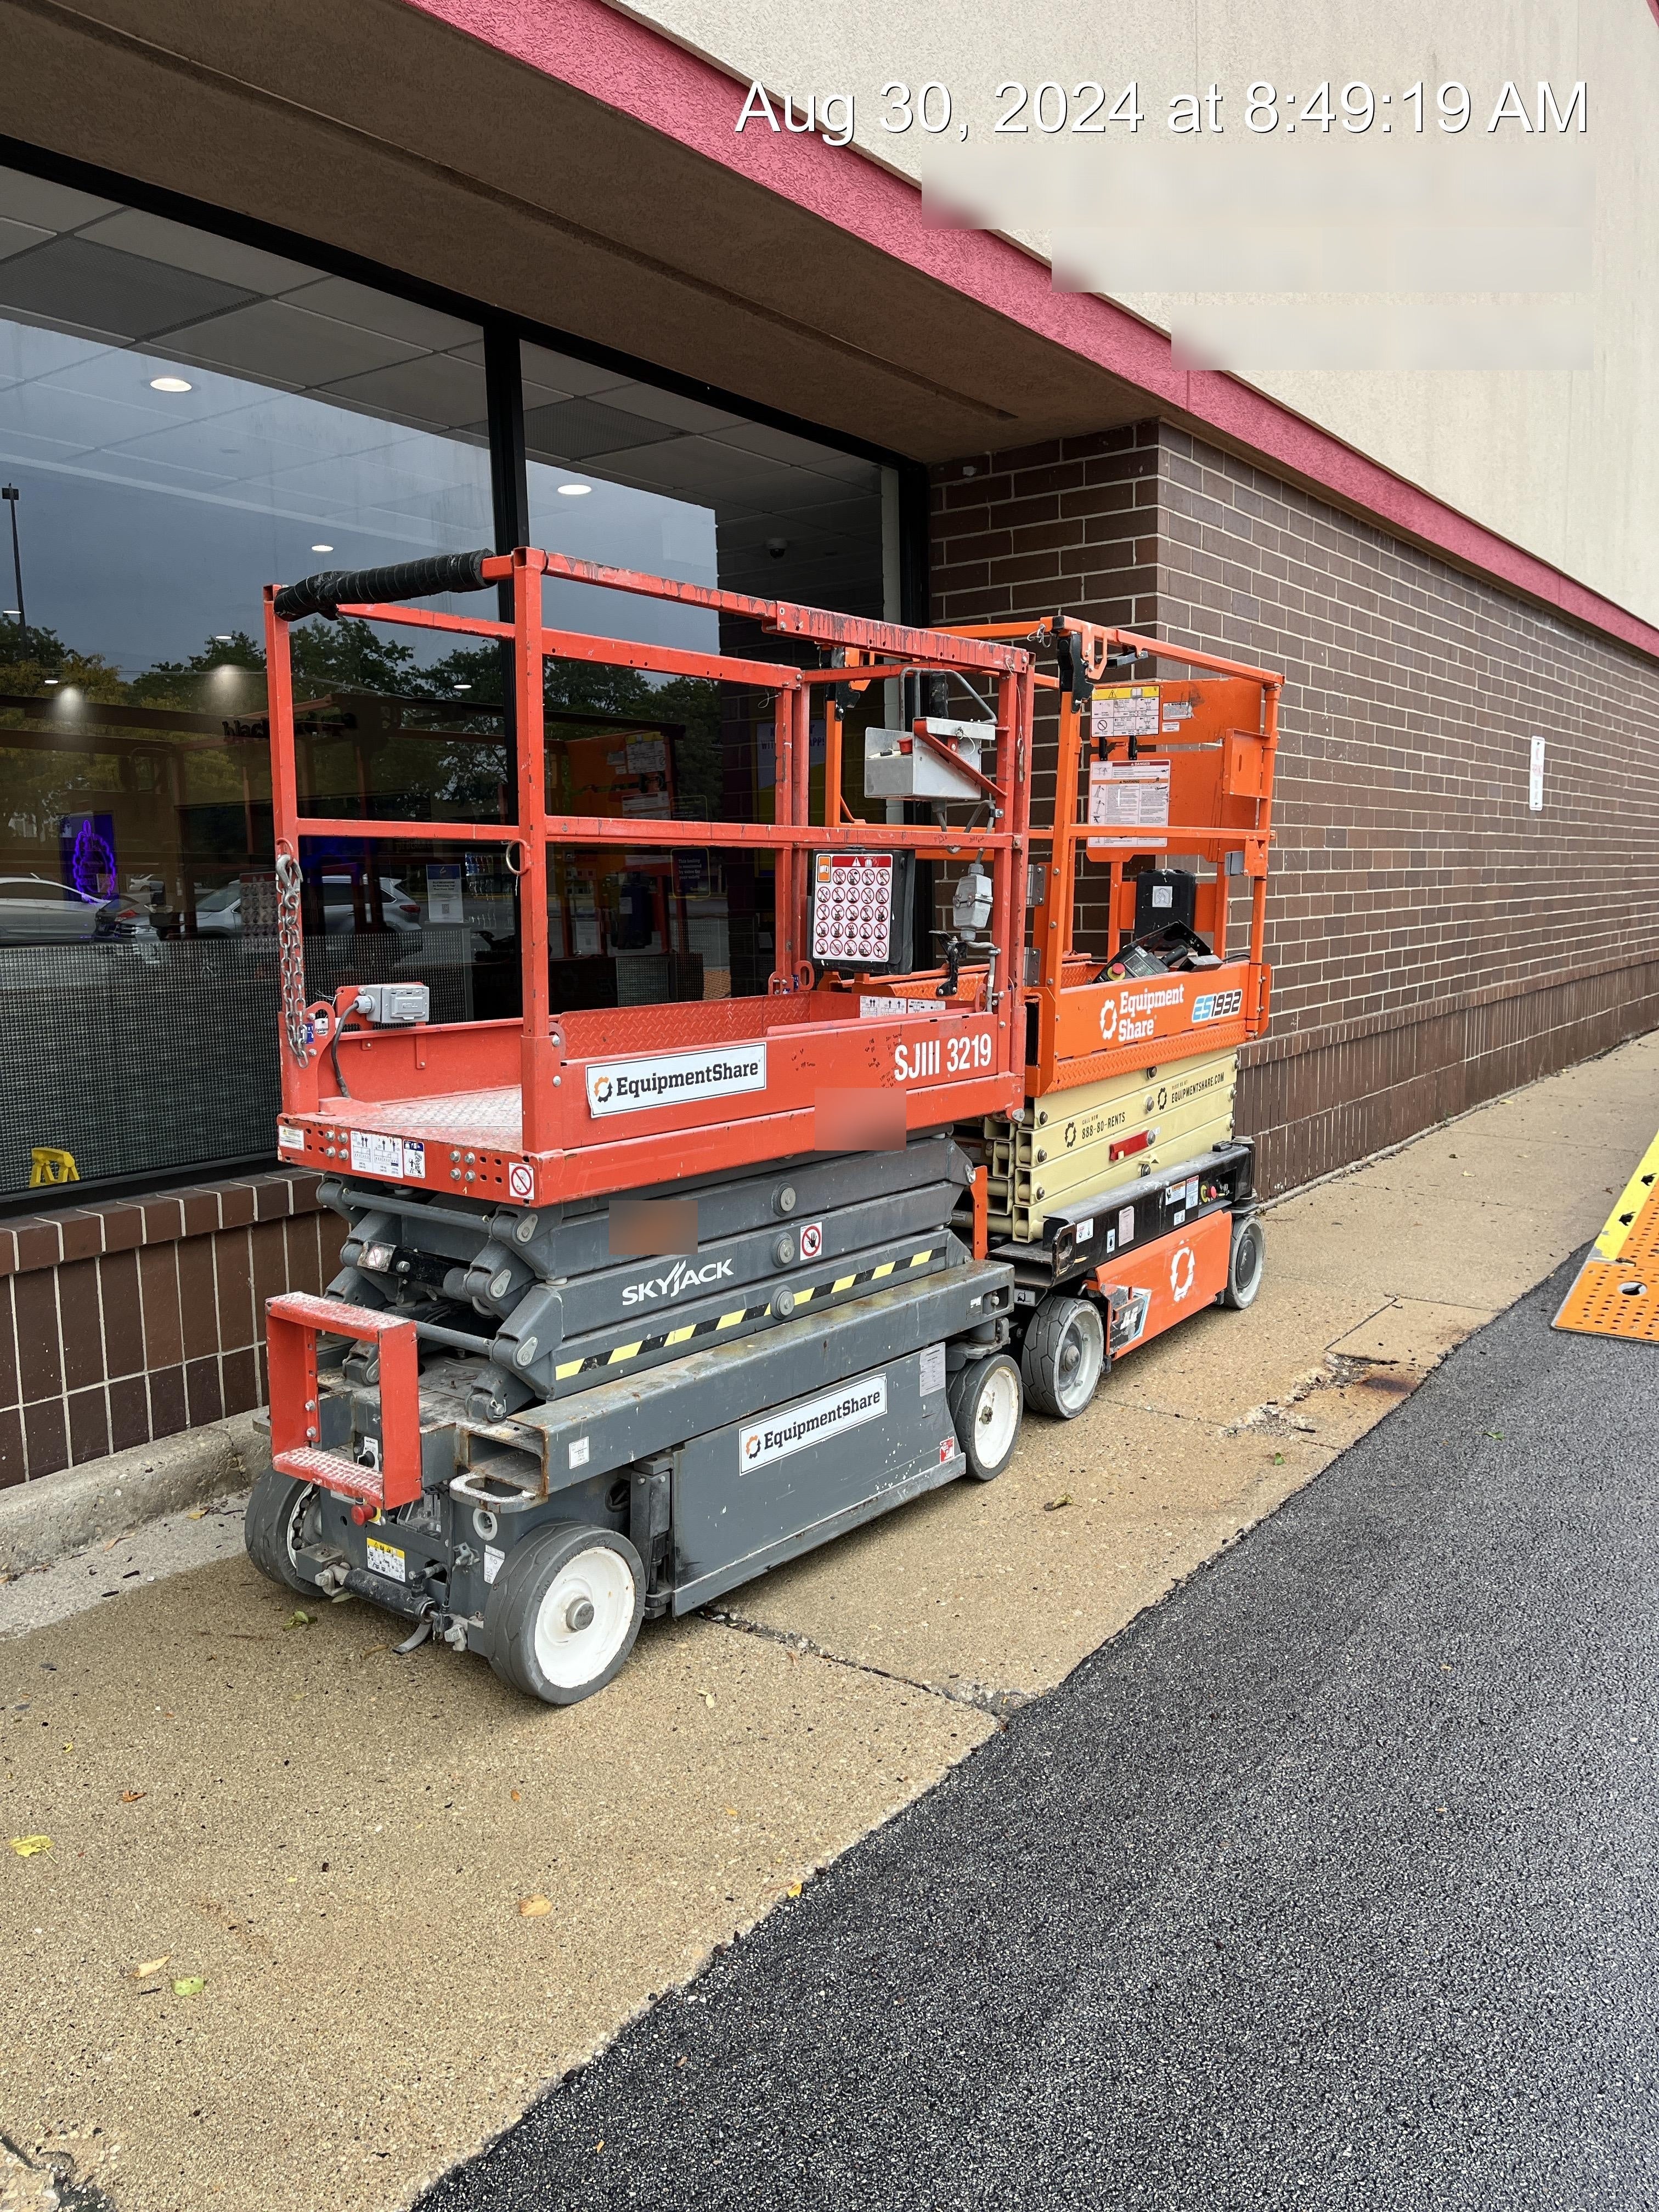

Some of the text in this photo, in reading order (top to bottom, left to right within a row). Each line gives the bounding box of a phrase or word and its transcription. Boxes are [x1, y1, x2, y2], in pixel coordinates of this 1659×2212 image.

[1119, 984, 1184, 1017] Equipment
[1193, 990, 1242, 1022] ES1932
[1119, 1018, 1155, 1042] Share
[894, 1041, 941, 1082] SJIII
[946, 1032, 992, 1073] 3219
[616, 1060, 759, 1098] EquipmentShare
[1171, 1071, 1224, 1103] EQUIPMENTSHARE.COM
[1082, 1116, 1091, 1125] CALL
[1082, 1111, 1126, 1140] 888-80-RENTS
[622, 1258, 735, 1306] SKYJACK
[764, 1389, 880, 1450] EquipmentShare
